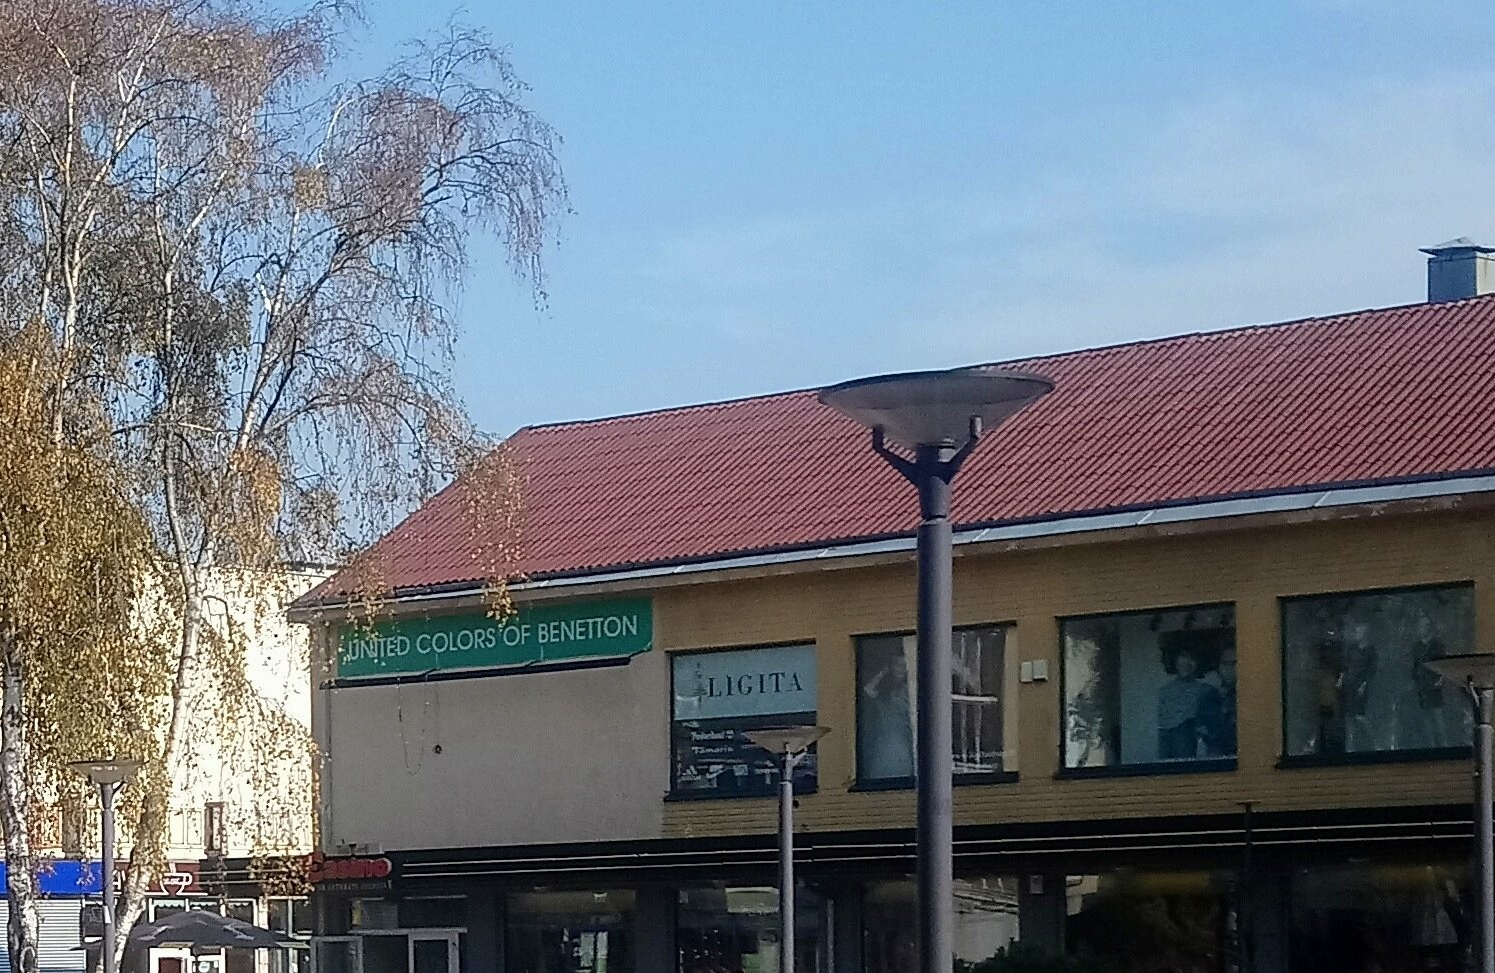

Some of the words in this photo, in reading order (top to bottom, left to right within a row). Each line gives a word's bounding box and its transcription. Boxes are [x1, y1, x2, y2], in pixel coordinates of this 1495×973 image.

[347, 636, 410, 661] UNITED
[416, 629, 496, 654] COLORS
[503, 624, 531, 646] OF
[539, 615, 639, 644] BENETTON
[707, 671, 803, 698] LIGITA
